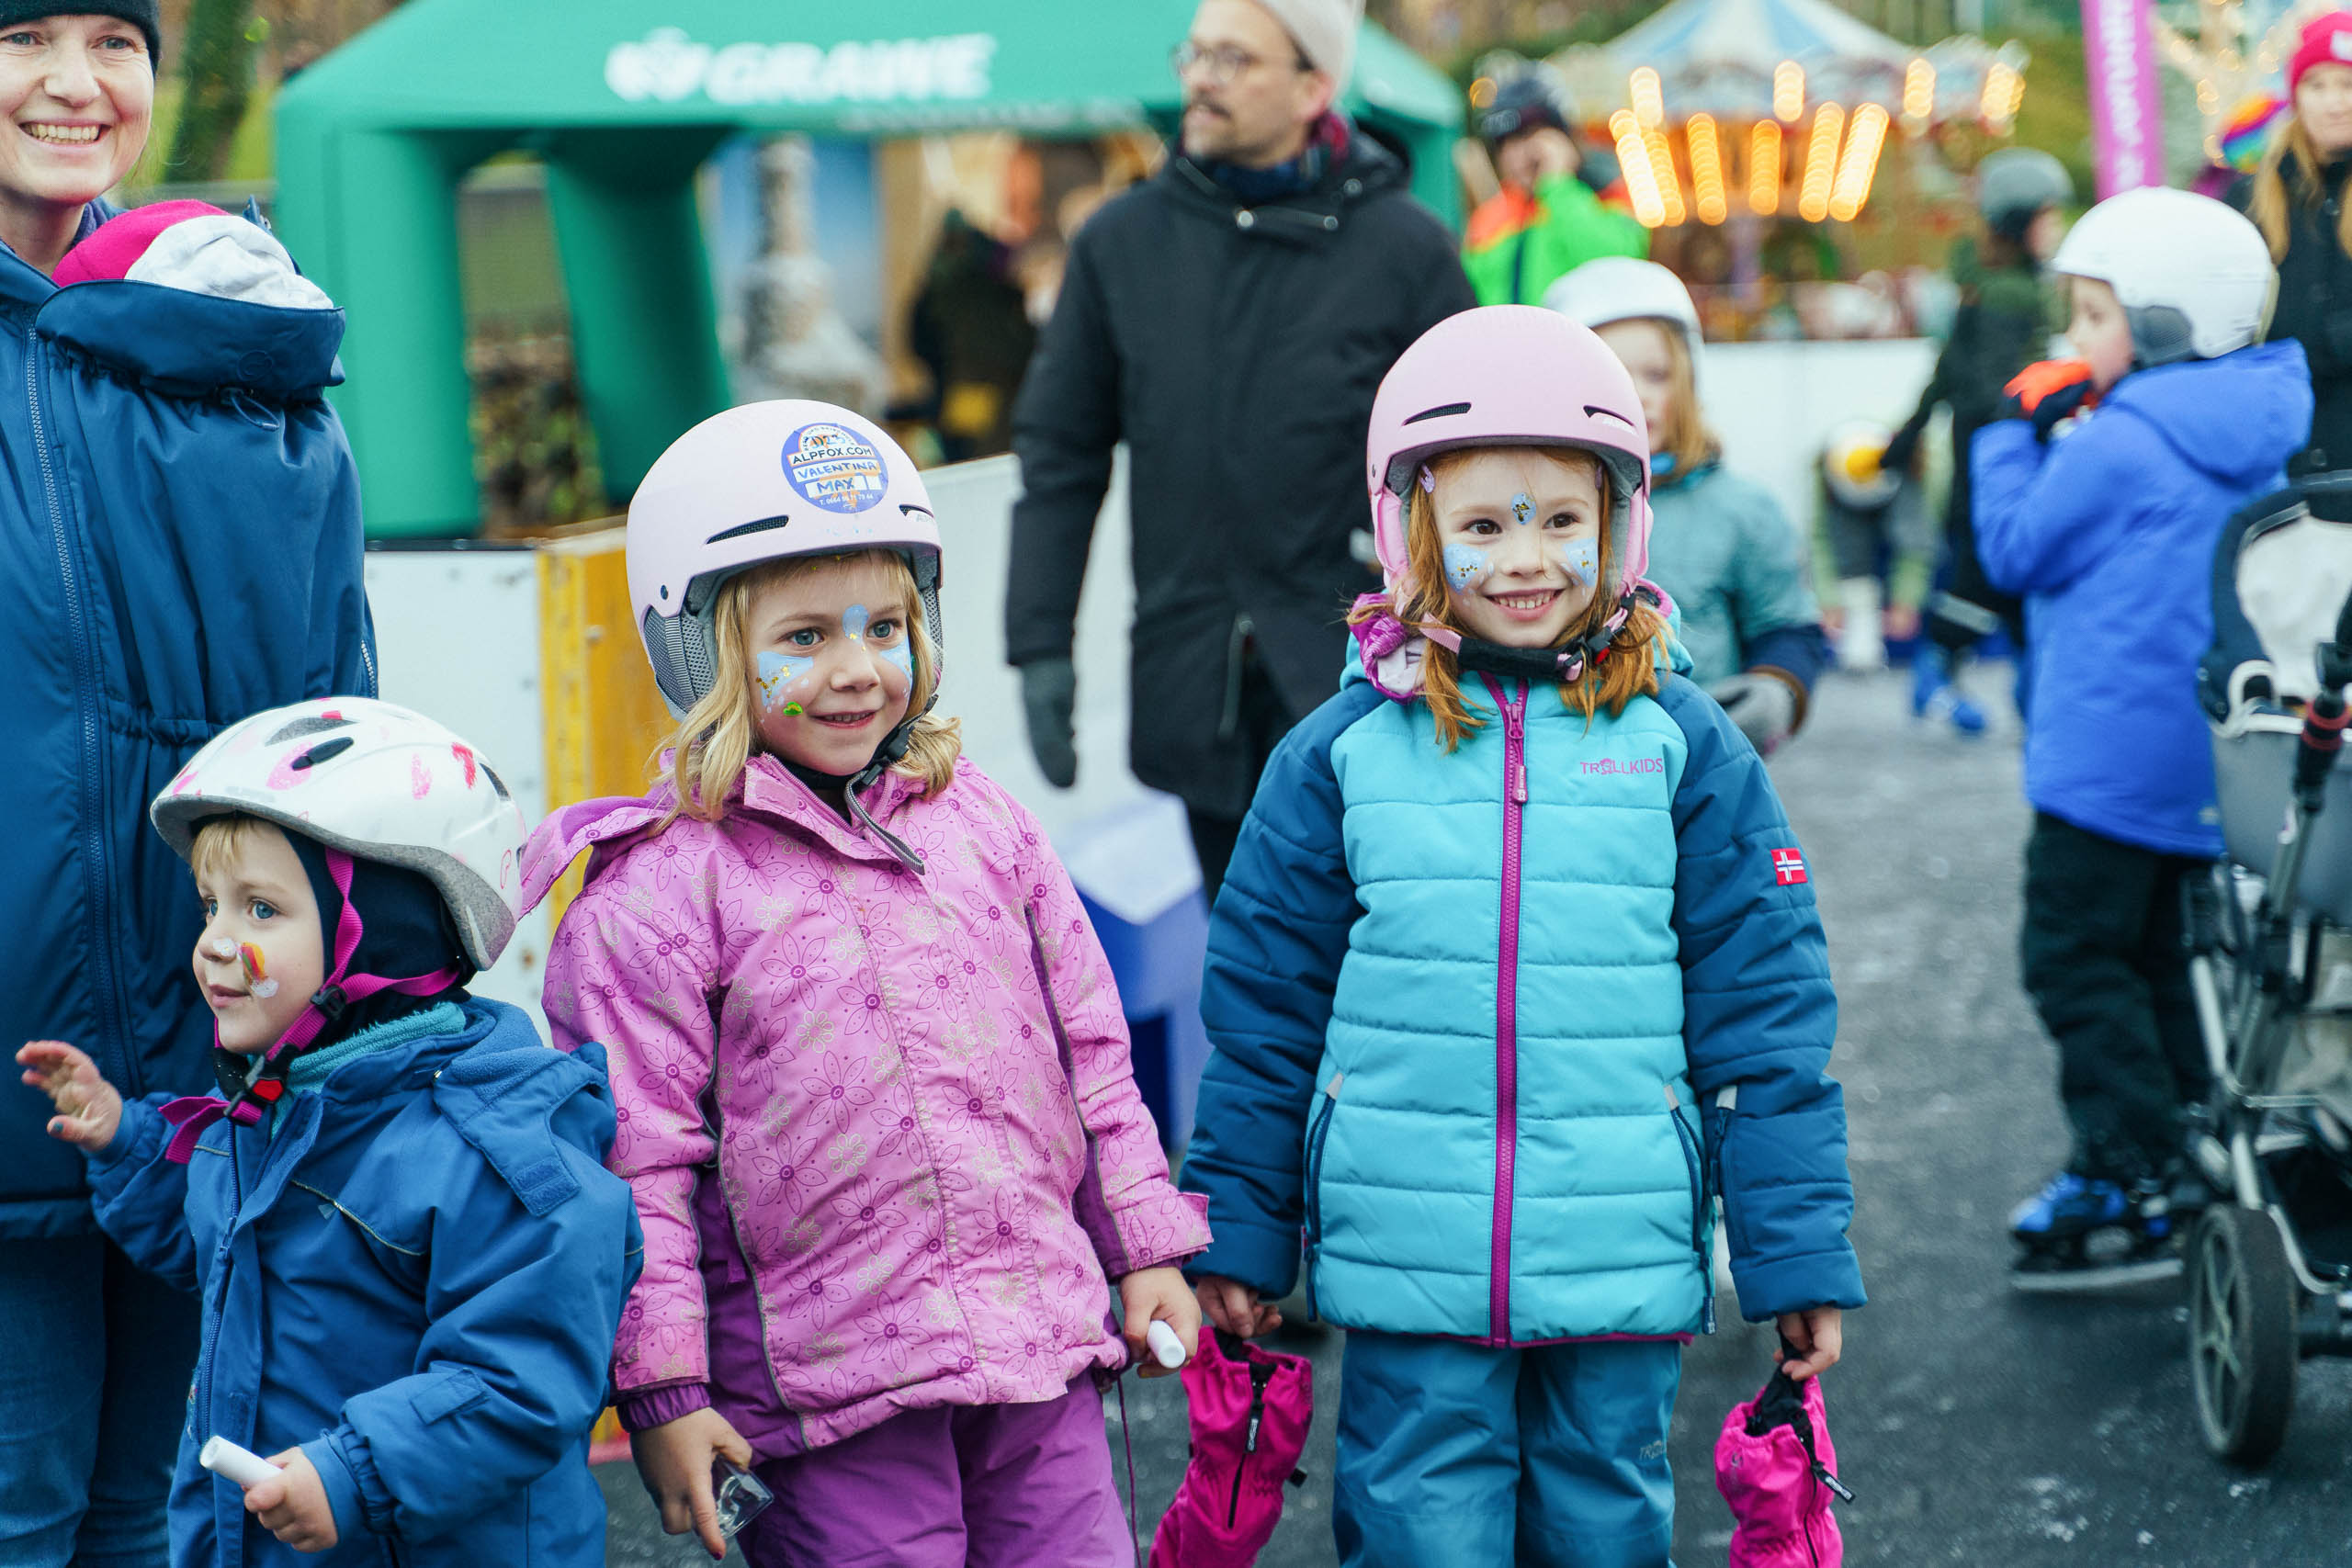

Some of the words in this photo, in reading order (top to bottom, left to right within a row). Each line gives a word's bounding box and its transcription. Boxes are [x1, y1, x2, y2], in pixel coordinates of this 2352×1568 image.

[793, 446, 872, 464] ALPFOX.COM
[797, 461, 877, 479] VALENTINA
[817, 478, 855, 493] MAX
